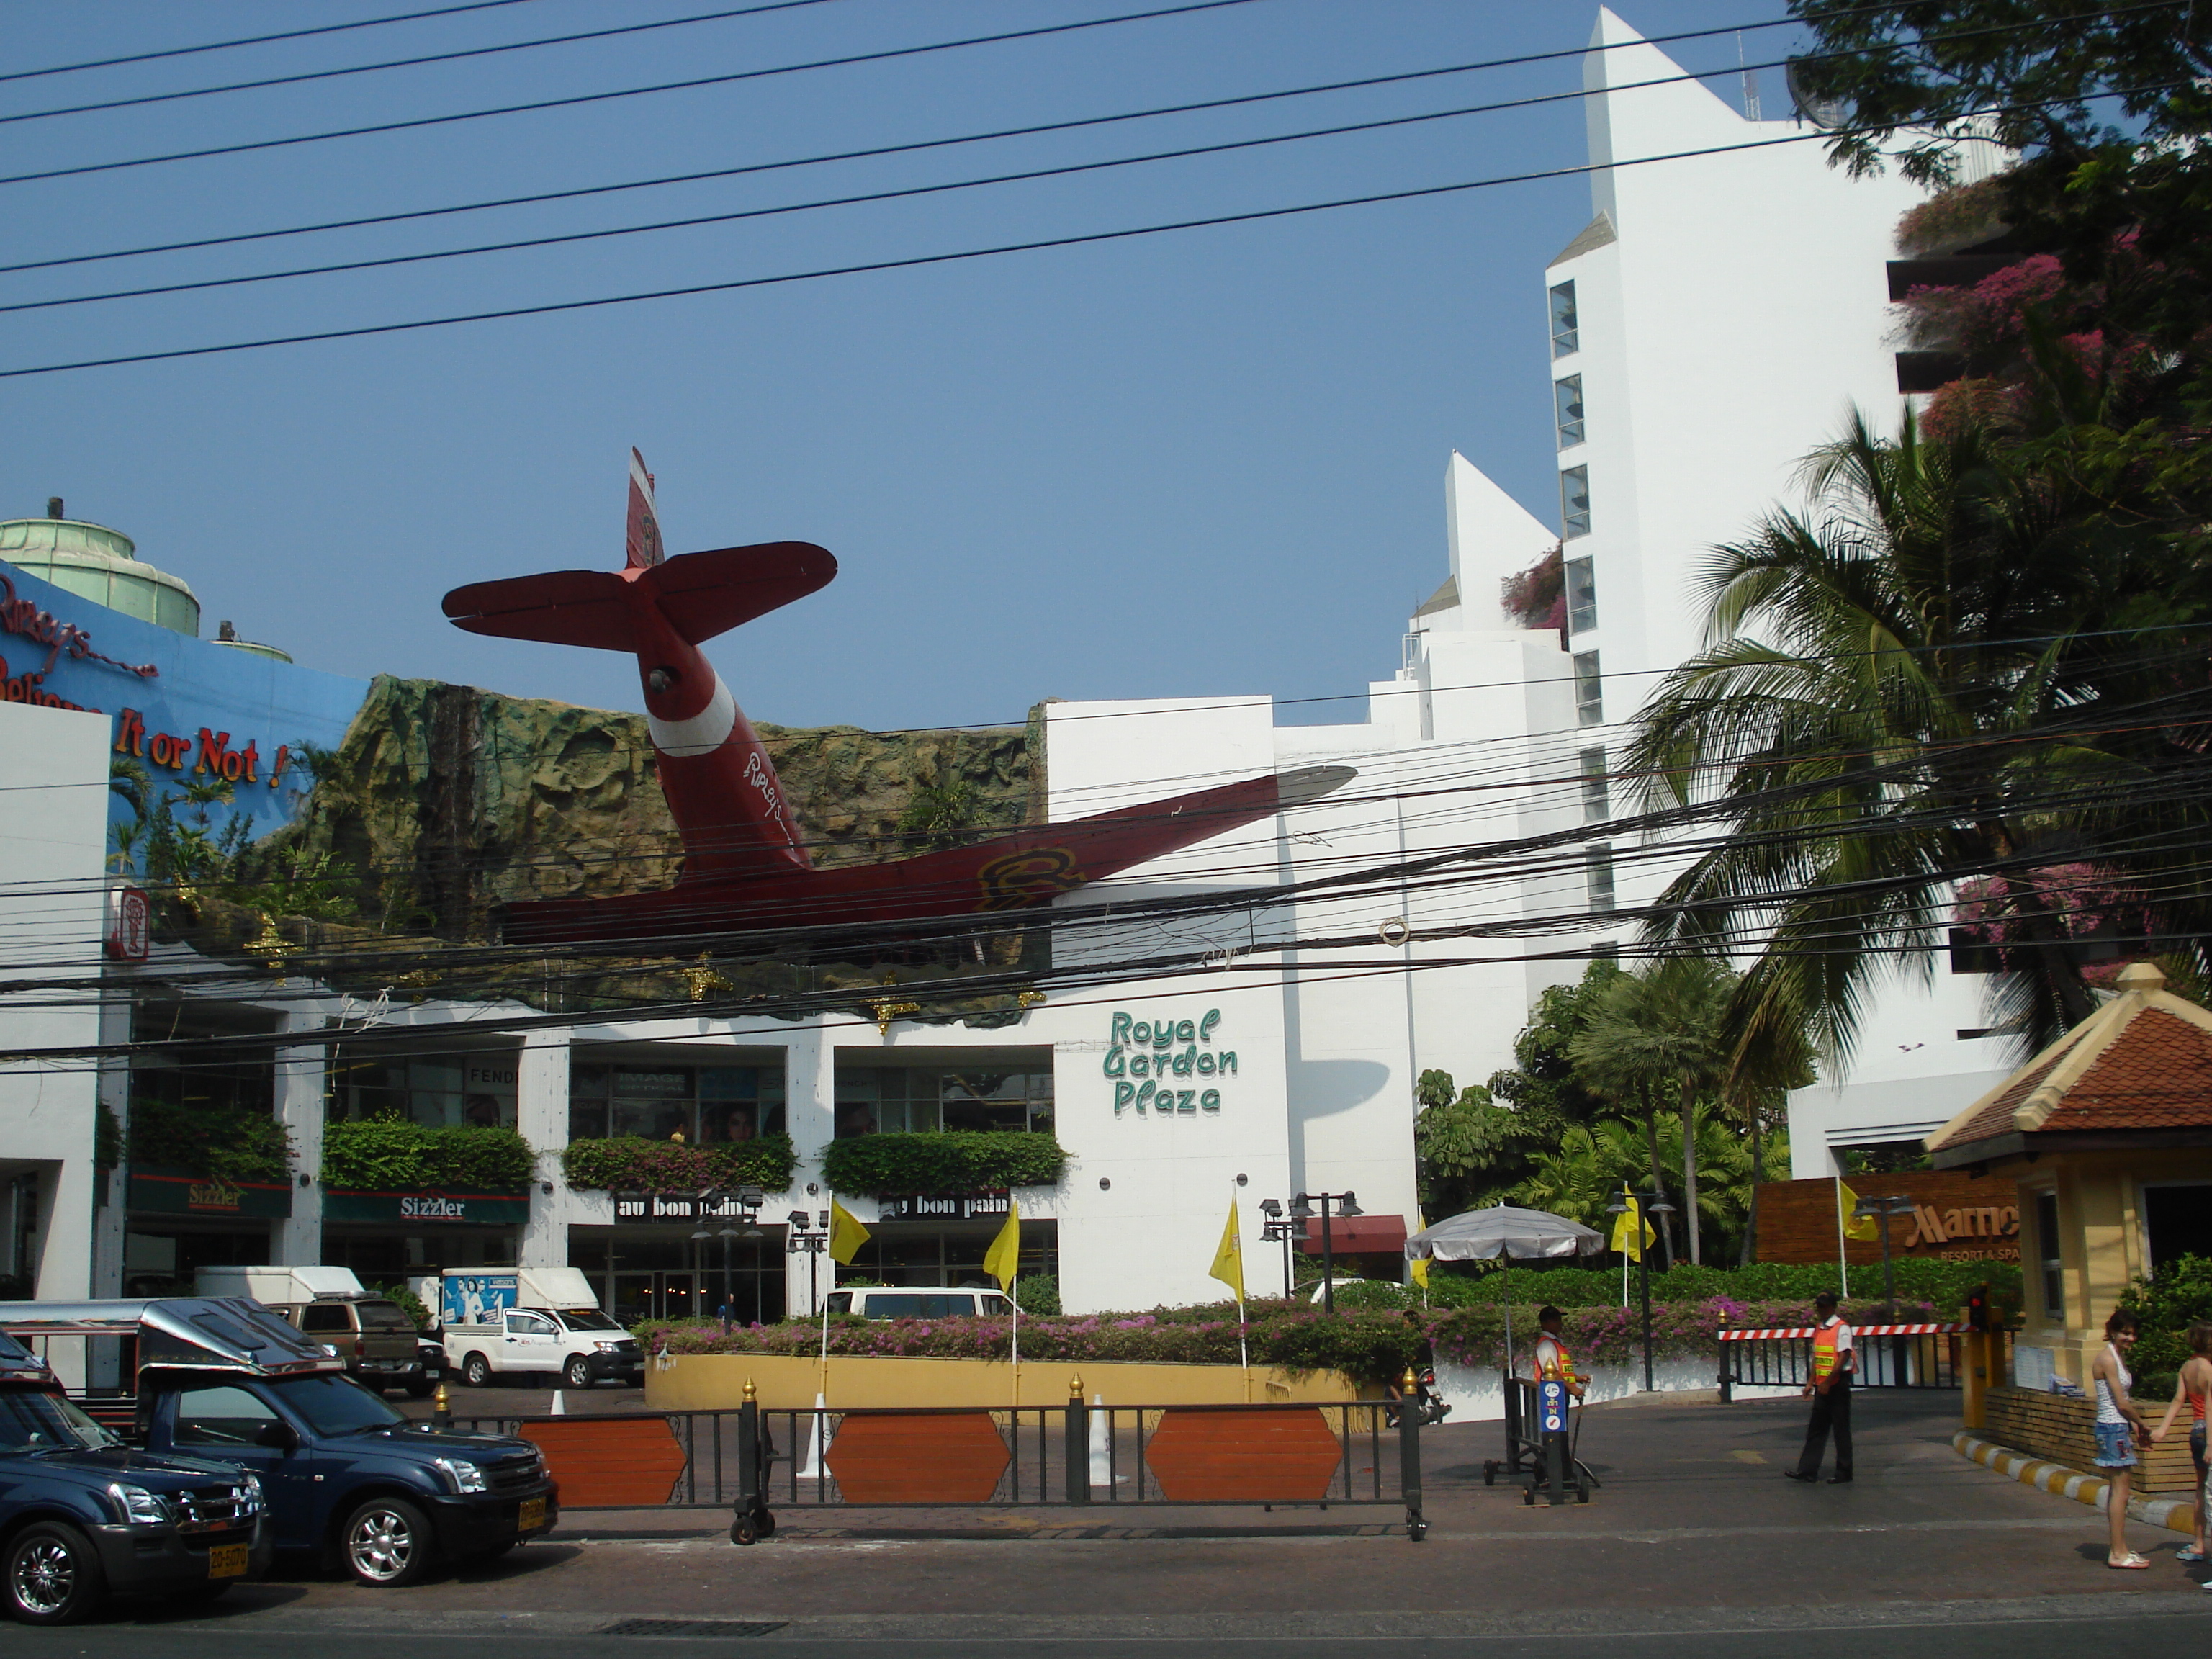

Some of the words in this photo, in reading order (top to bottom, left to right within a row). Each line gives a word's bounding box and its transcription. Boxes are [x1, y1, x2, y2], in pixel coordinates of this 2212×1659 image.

[115, 708, 145, 757] It
[150, 733, 192, 770] or
[194, 727, 258, 782] Not
[1111, 1008, 1220, 1048] Royal
[1103, 1044, 1237, 1076] Garden
[619, 1073, 685, 1083] IMAGE
[1115, 1079, 1220, 1113] Plaza
[189, 1184, 240, 1206] Sizzler
[619, 1201, 645, 1216] au
[653, 1196, 691, 1216] bon
[917, 1195, 956, 1214] bon
[963, 1192, 1008, 1218] pain
[400, 1197, 466, 1216] Sizzler
[1941, 1251, 1984, 1262] RESORT
[1998, 1249, 2020, 1260] SPA
[212, 1547, 246, 1568] 20-5070
